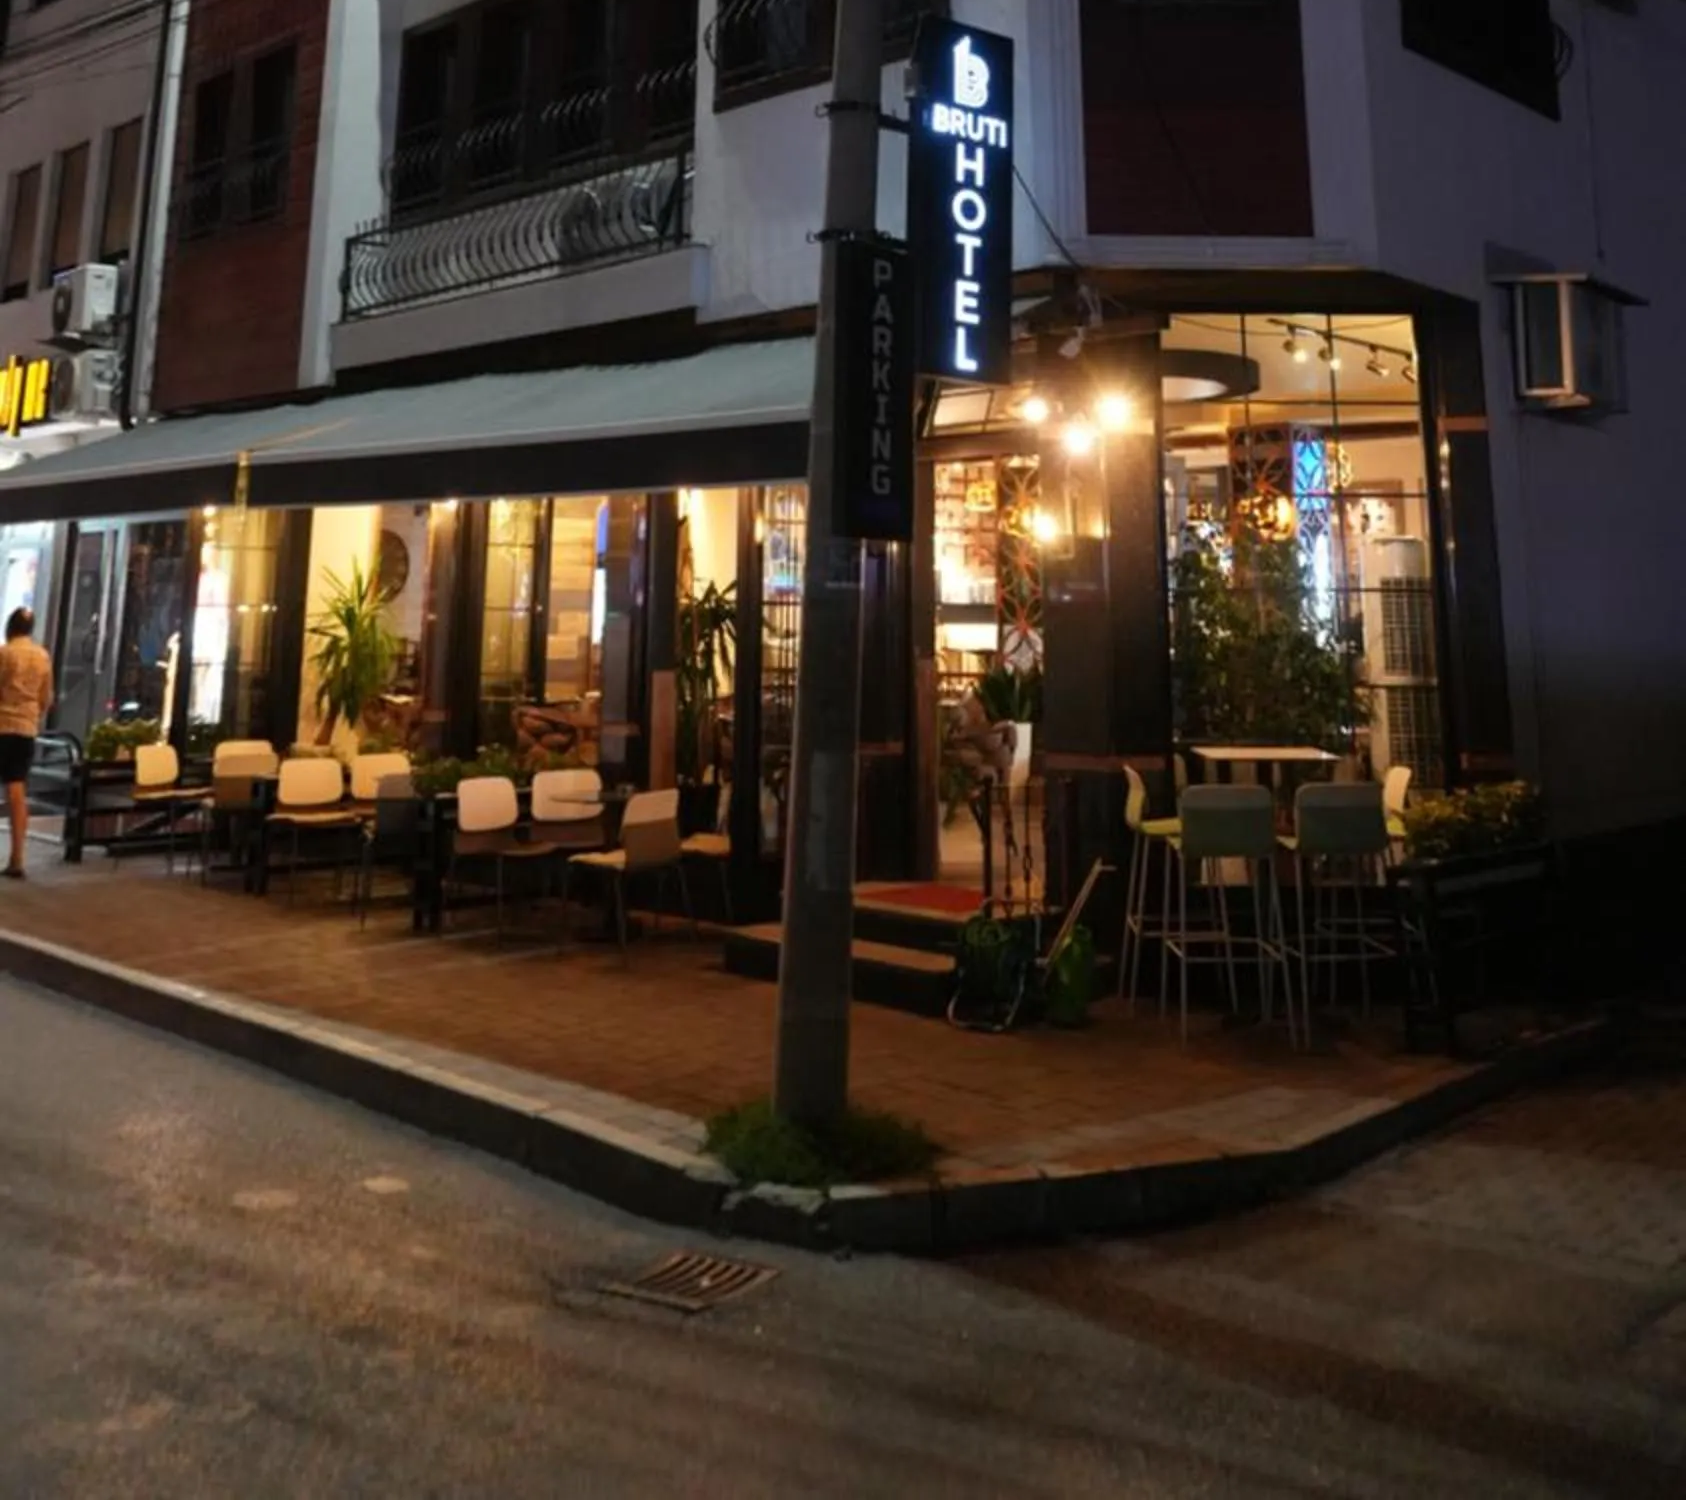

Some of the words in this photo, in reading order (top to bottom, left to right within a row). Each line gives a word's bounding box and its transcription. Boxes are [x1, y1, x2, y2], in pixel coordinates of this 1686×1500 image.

[931, 103, 1007, 148] BRUTI
[951, 141, 987, 371] HOTEL
[870, 256, 895, 495] PARKING
